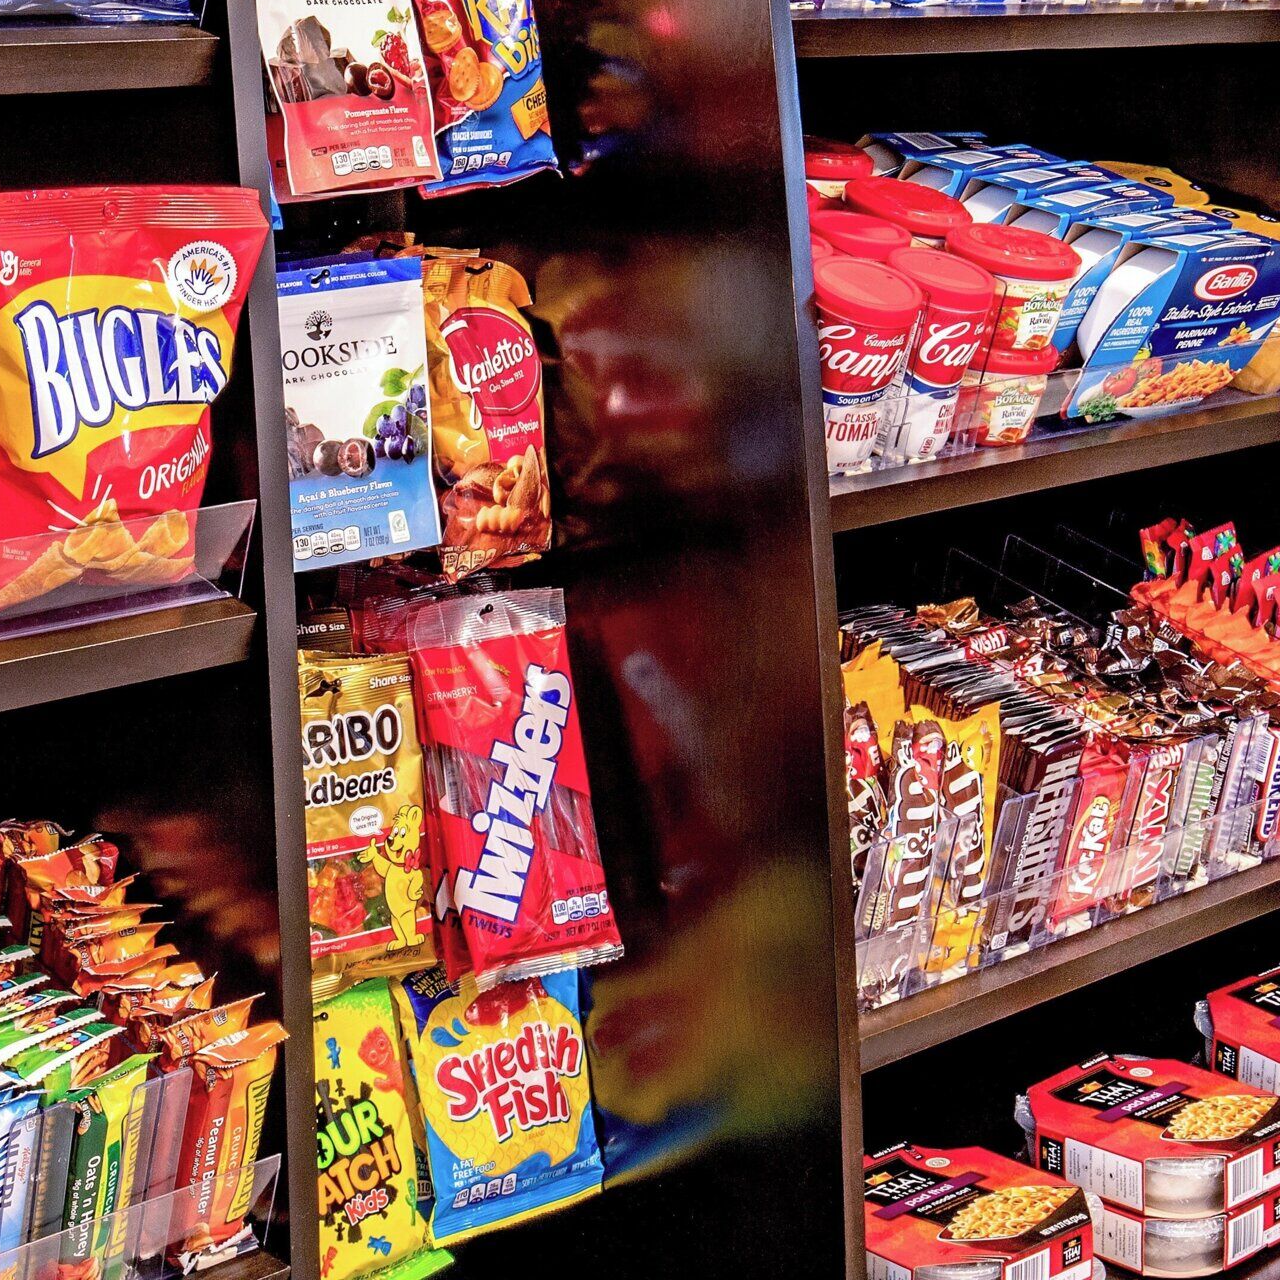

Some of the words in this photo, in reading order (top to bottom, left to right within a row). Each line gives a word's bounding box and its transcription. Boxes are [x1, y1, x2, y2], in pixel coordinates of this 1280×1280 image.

[344, 107, 387, 119] Pomegranate
[389, 105, 409, 114] Flavor
[1209, 272, 1254, 294] Barilla
[1022, 298, 1063, 314] BOYARDEE
[1128, 306, 1153, 318] 100%
[1162, 305, 1221, 322] Italian-Style
[1222, 300, 1254, 316] Entrées
[1028, 316, 1052, 327] Ravioli
[1110, 325, 1148, 336] INGREDIENTS
[1127, 318, 1144, 326] REAL
[1174, 327, 1218, 340] MARINARA
[1176, 337, 1204, 350] PENNE
[18, 302, 228, 460] BUGLES
[838, 396, 860, 405] Soup
[844, 412, 877, 423] CLASSIC
[138, 430, 209, 498] ORIGINAL
[427, 686, 478, 702] STRAWBERRY
[454, 663, 571, 922] Twizzlers
[469, 913, 513, 939] TWISTS
[436, 1022, 584, 1120] Swedish
[1080, 1082, 1137, 1104] THAI
[1107, 1088, 1145, 1107] KITCHEN
[1122, 1099, 1144, 1112] pad
[1141, 1091, 1163, 1105] thai
[483, 1071, 570, 1143] Fish
[208, 1117, 224, 1166] Peanut
[225, 1126, 242, 1189] CRUNCHY
[197, 1169, 216, 1215] Butter
[864, 1173, 928, 1198] THAI
[905, 1193, 929, 1208] pad
[928, 1183, 954, 1199] thai
[344, 1189, 389, 1226] Kids
